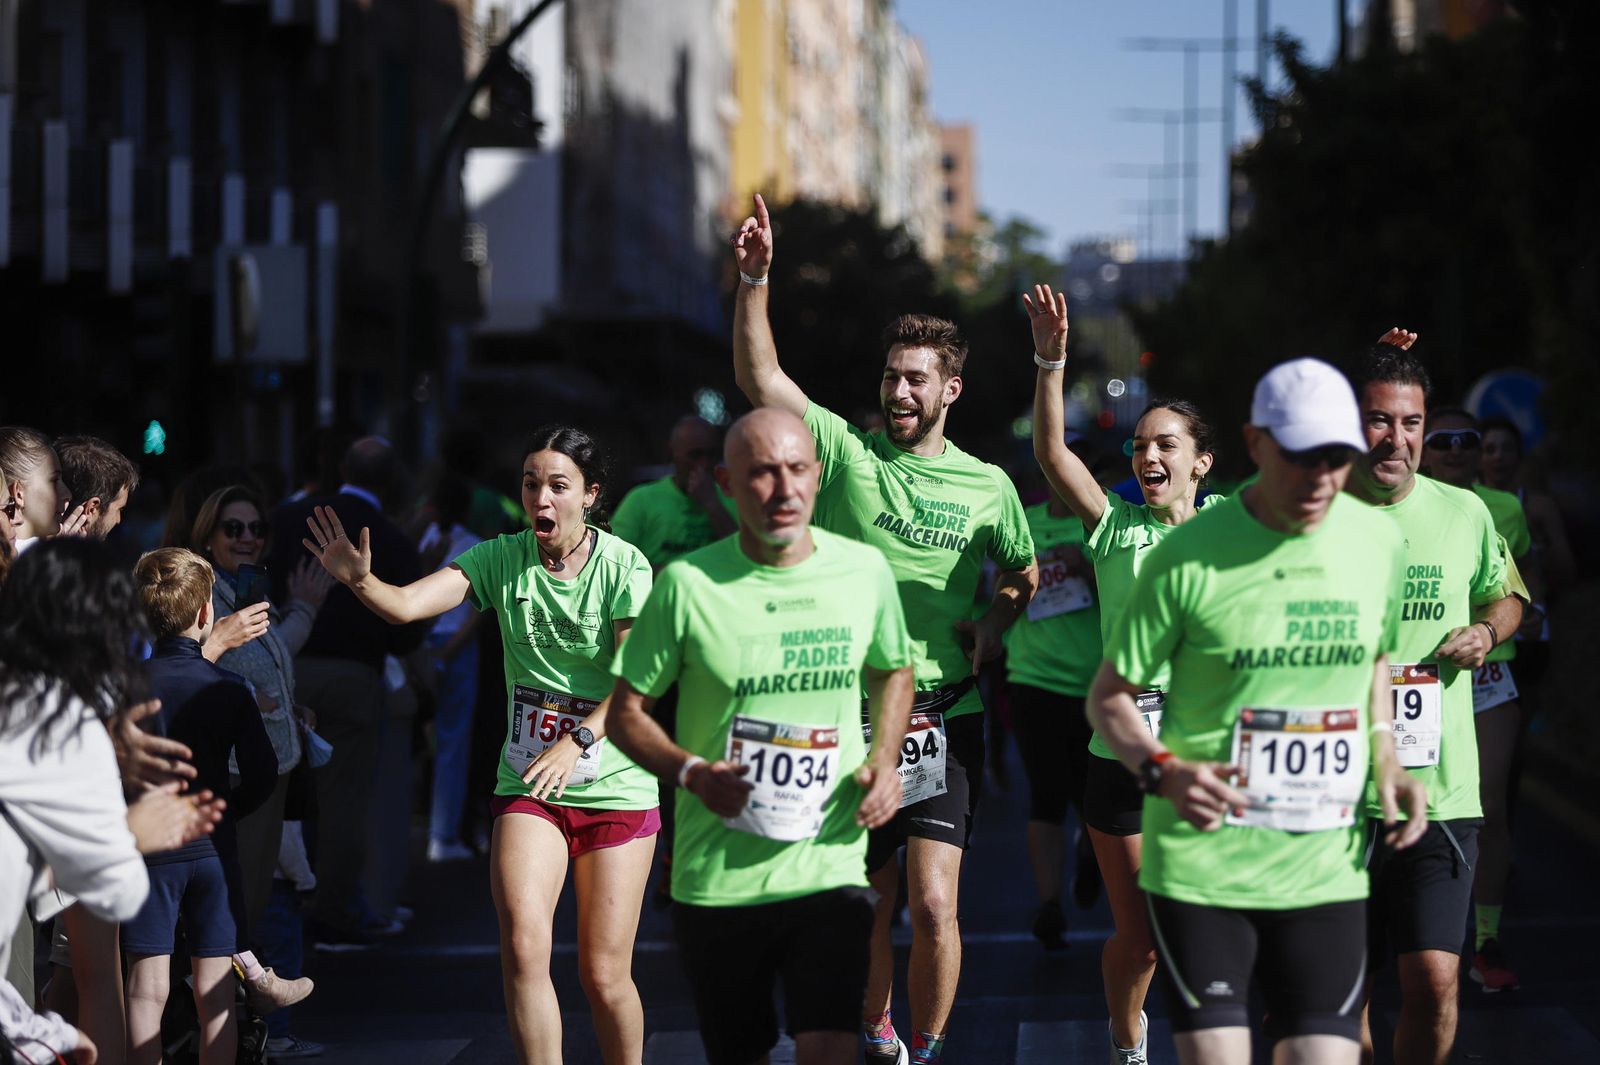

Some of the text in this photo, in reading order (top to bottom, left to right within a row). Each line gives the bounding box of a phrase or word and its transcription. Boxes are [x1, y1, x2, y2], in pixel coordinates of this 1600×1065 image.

[912, 495, 971, 518] MEMORIAL
[873, 511, 969, 554] MARCELINO
[911, 508, 968, 534] PADRE
[1405, 565, 1444, 580] ORIAL
[1285, 600, 1360, 617] MEMORIAL
[1401, 602, 1446, 621] LINO
[780, 626, 853, 647] MEMORIAL
[1285, 620, 1358, 641] PADRE
[782, 646, 850, 670] PADRE
[1230, 645, 1366, 671] MARCELINO
[734, 669, 857, 698] MARCELINO
[1472, 662, 1503, 685] 28
[526, 710, 584, 743] 158
[897, 731, 938, 769] 94
[1261, 738, 1350, 775] 1019
[750, 748, 829, 789] 1034
[903, 765, 925, 776] MIGUEL
